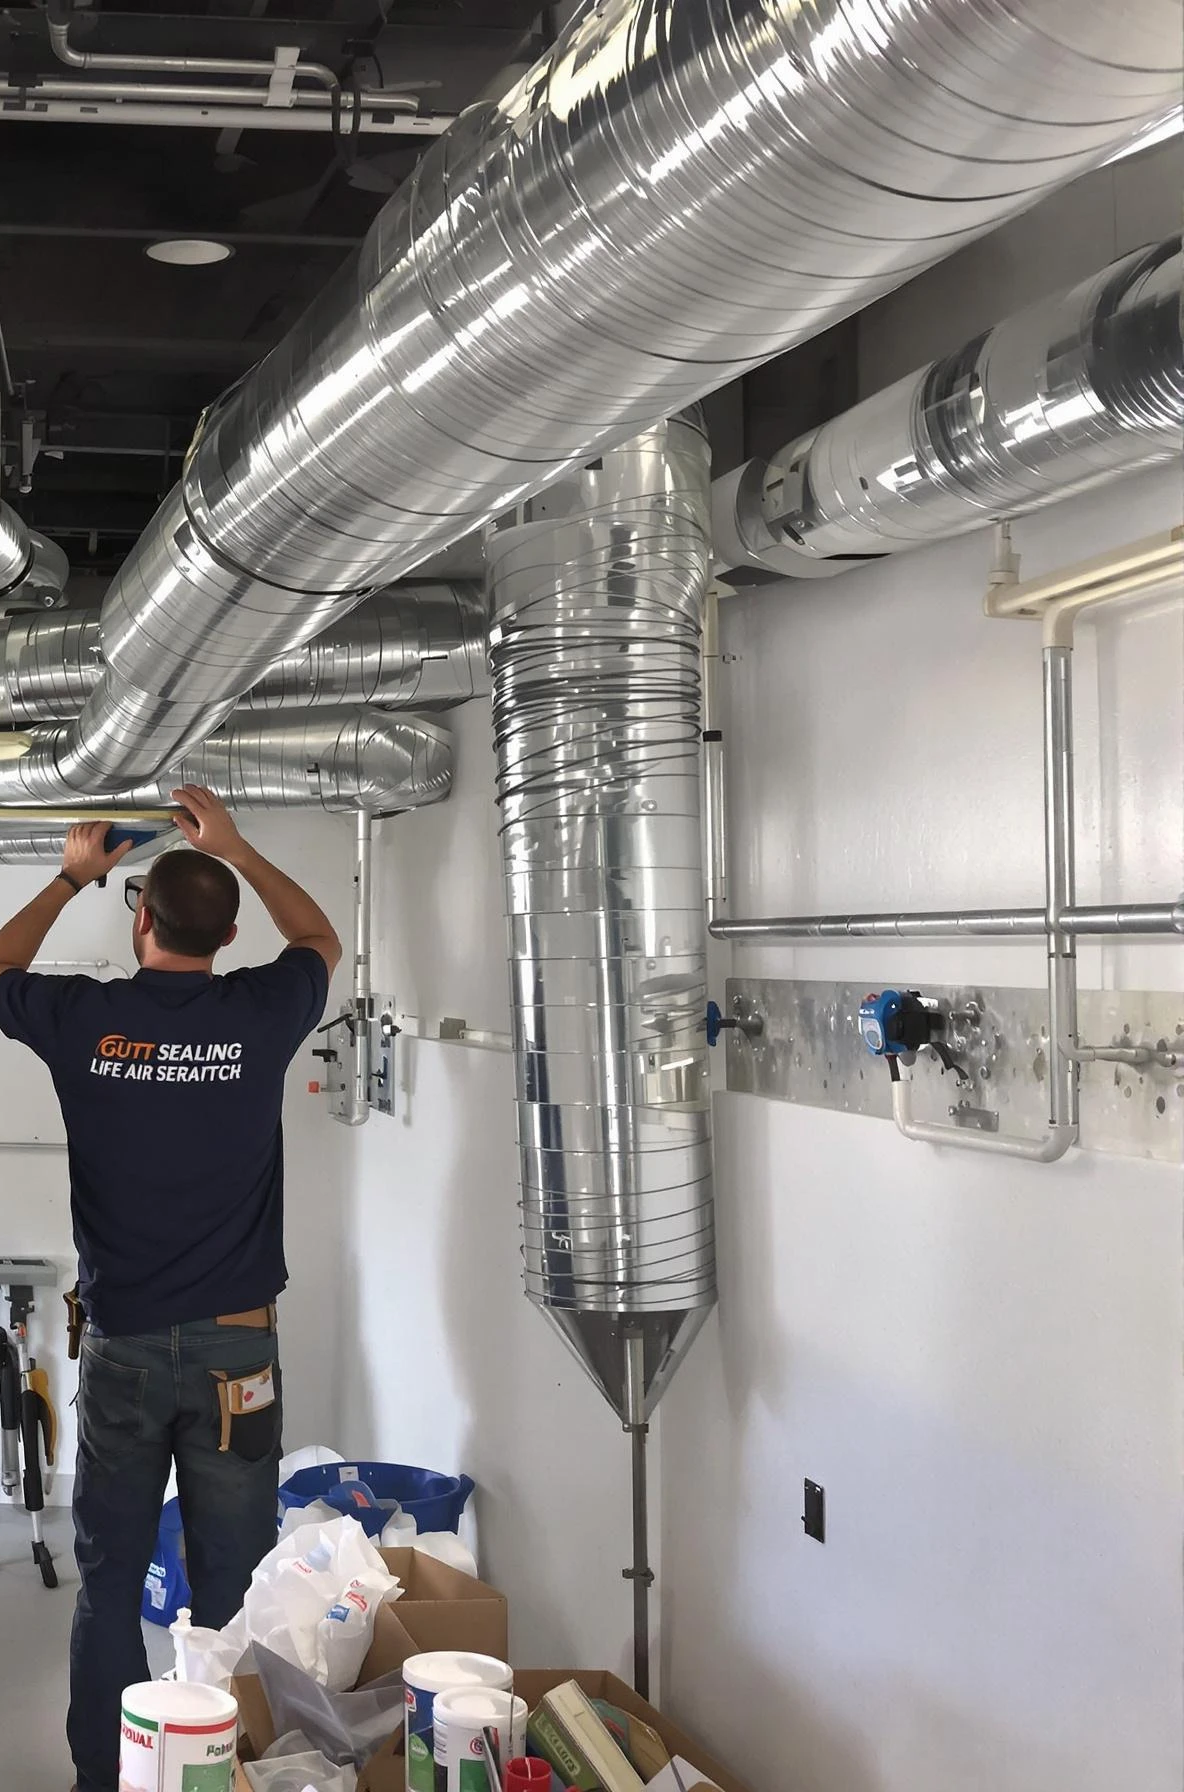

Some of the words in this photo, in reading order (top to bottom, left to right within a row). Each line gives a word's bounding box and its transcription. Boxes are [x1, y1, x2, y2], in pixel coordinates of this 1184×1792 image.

[157, 1042, 243, 1062] SEALING
[89, 1057, 124, 1078] LIFE
[124, 1063, 154, 1081] AIR
